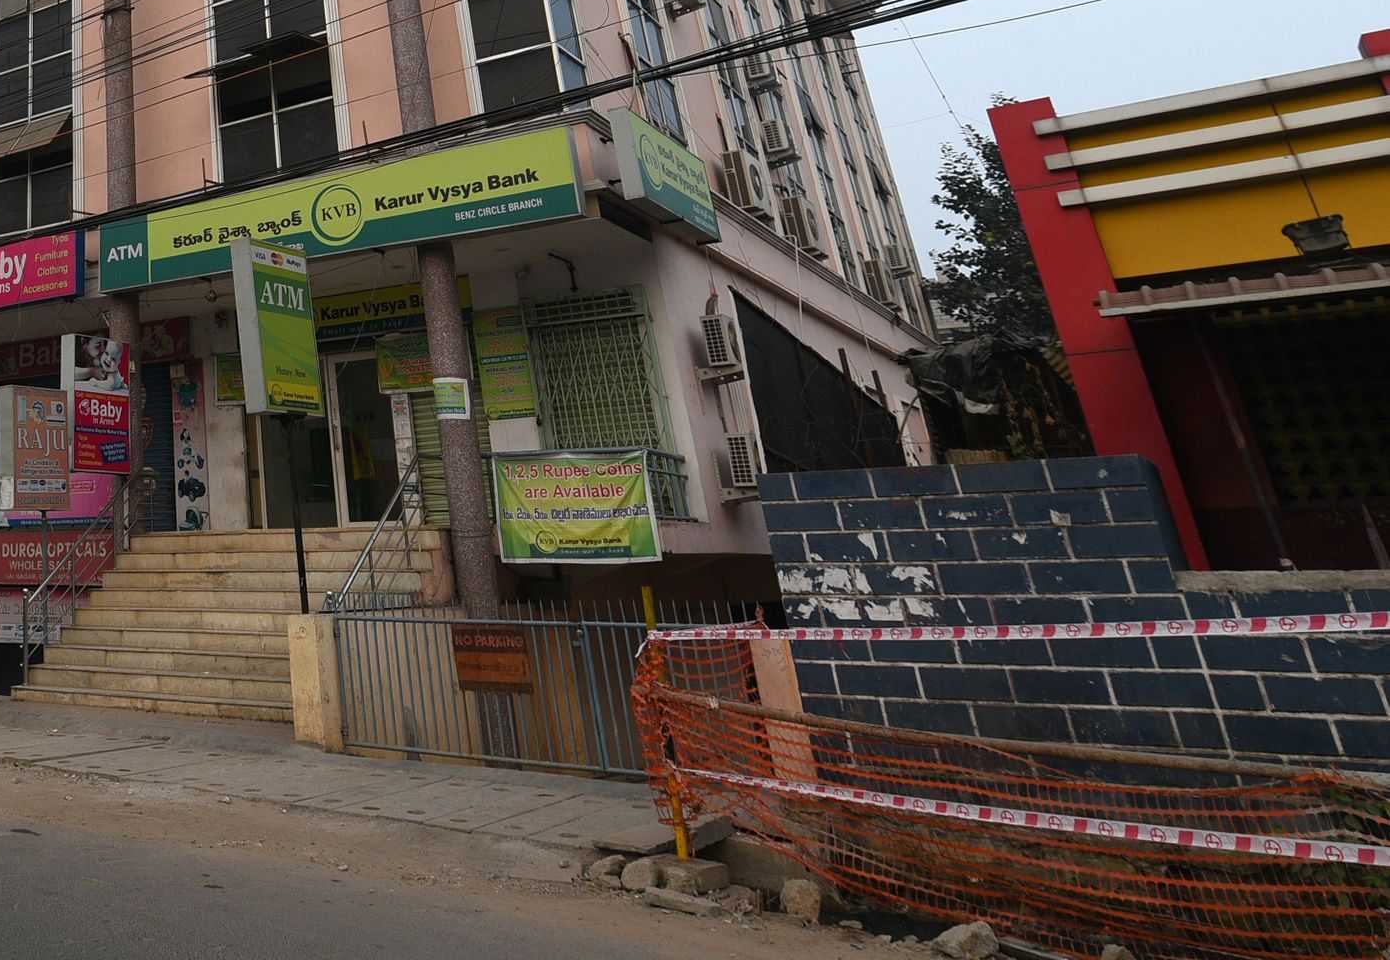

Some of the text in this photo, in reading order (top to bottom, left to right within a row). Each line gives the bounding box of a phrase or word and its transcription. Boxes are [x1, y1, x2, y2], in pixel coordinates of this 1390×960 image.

[375, 168, 539, 211] Karur Vysya Bank
[321, 201, 357, 222] KVB
[454, 197, 543, 222] BENZ CIRCLE BRANCH
[107, 243, 142, 262] ATM
[37, 265, 68, 277] Clothing
[260, 280, 305, 312] ATM
[321, 304, 360, 321] Karur
[364, 297, 407, 318] Vysya
[90, 399, 122, 422] Baby
[18, 427, 67, 457] RAJU
[543, 464, 590, 480] Rupee
[595, 462, 643, 477] Coins
[525, 483, 625, 498] are Available
[1, 542, 42, 558] DURGA
[47, 541, 107, 557] OPTCALS
[9, 560, 42, 571] WHOLE
[454, 632, 524, 648] NO PARKING
